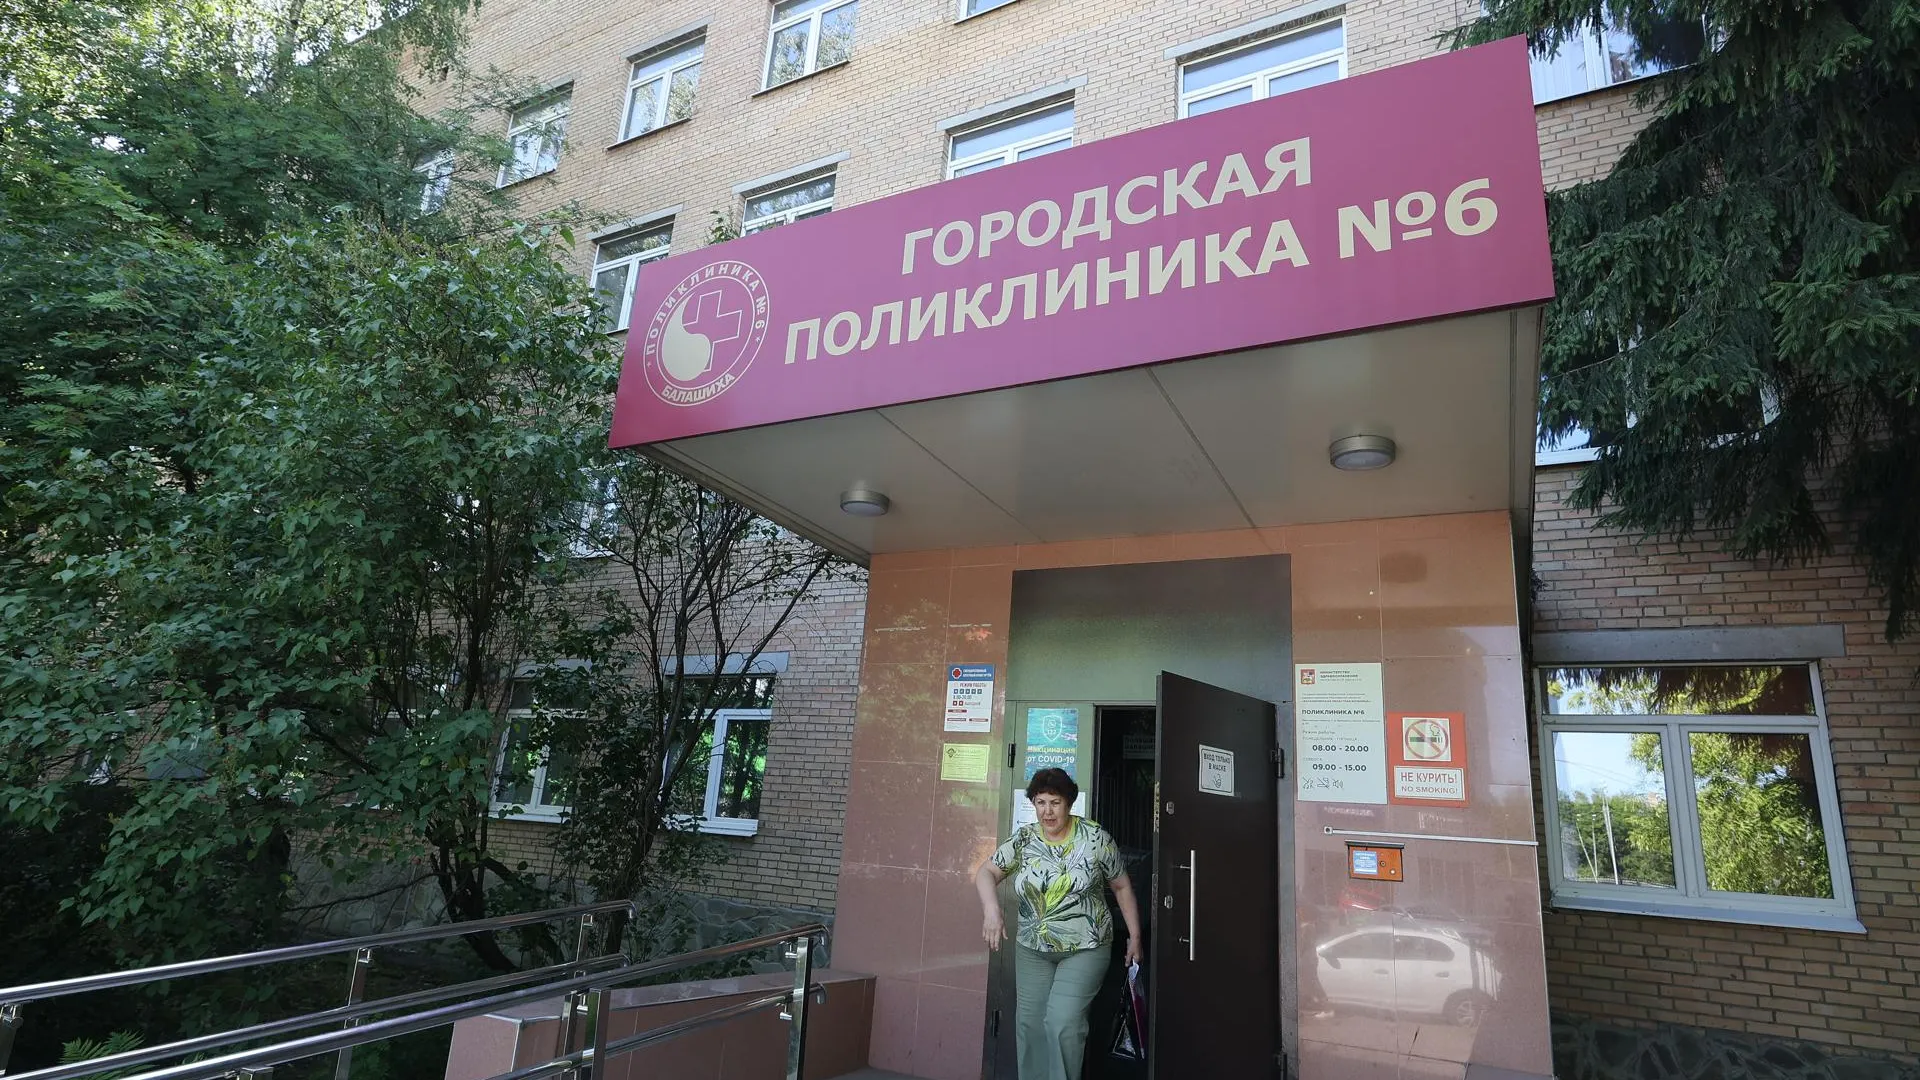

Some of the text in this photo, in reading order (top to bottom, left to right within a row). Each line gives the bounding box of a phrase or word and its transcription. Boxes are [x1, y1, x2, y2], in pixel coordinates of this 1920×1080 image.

[901, 139, 1312, 276] ГОРОДСКАЯ
[784, 177, 1498, 365] ПОЛИКЛИНИКА №6
[646, 264, 760, 355] ПОЛИКЛИНИКА
[661, 373, 735, 403] БАЛАШИХА
[1312, 744, 1336, 752] 08.00
[1038, 755, 1075, 764] COVID-19
[1312, 763, 1336, 771] 09.00
[1400, 771, 1457, 784] НЕ КУРИТЬ!
[1415, 786, 1458, 794] SMOKING!
